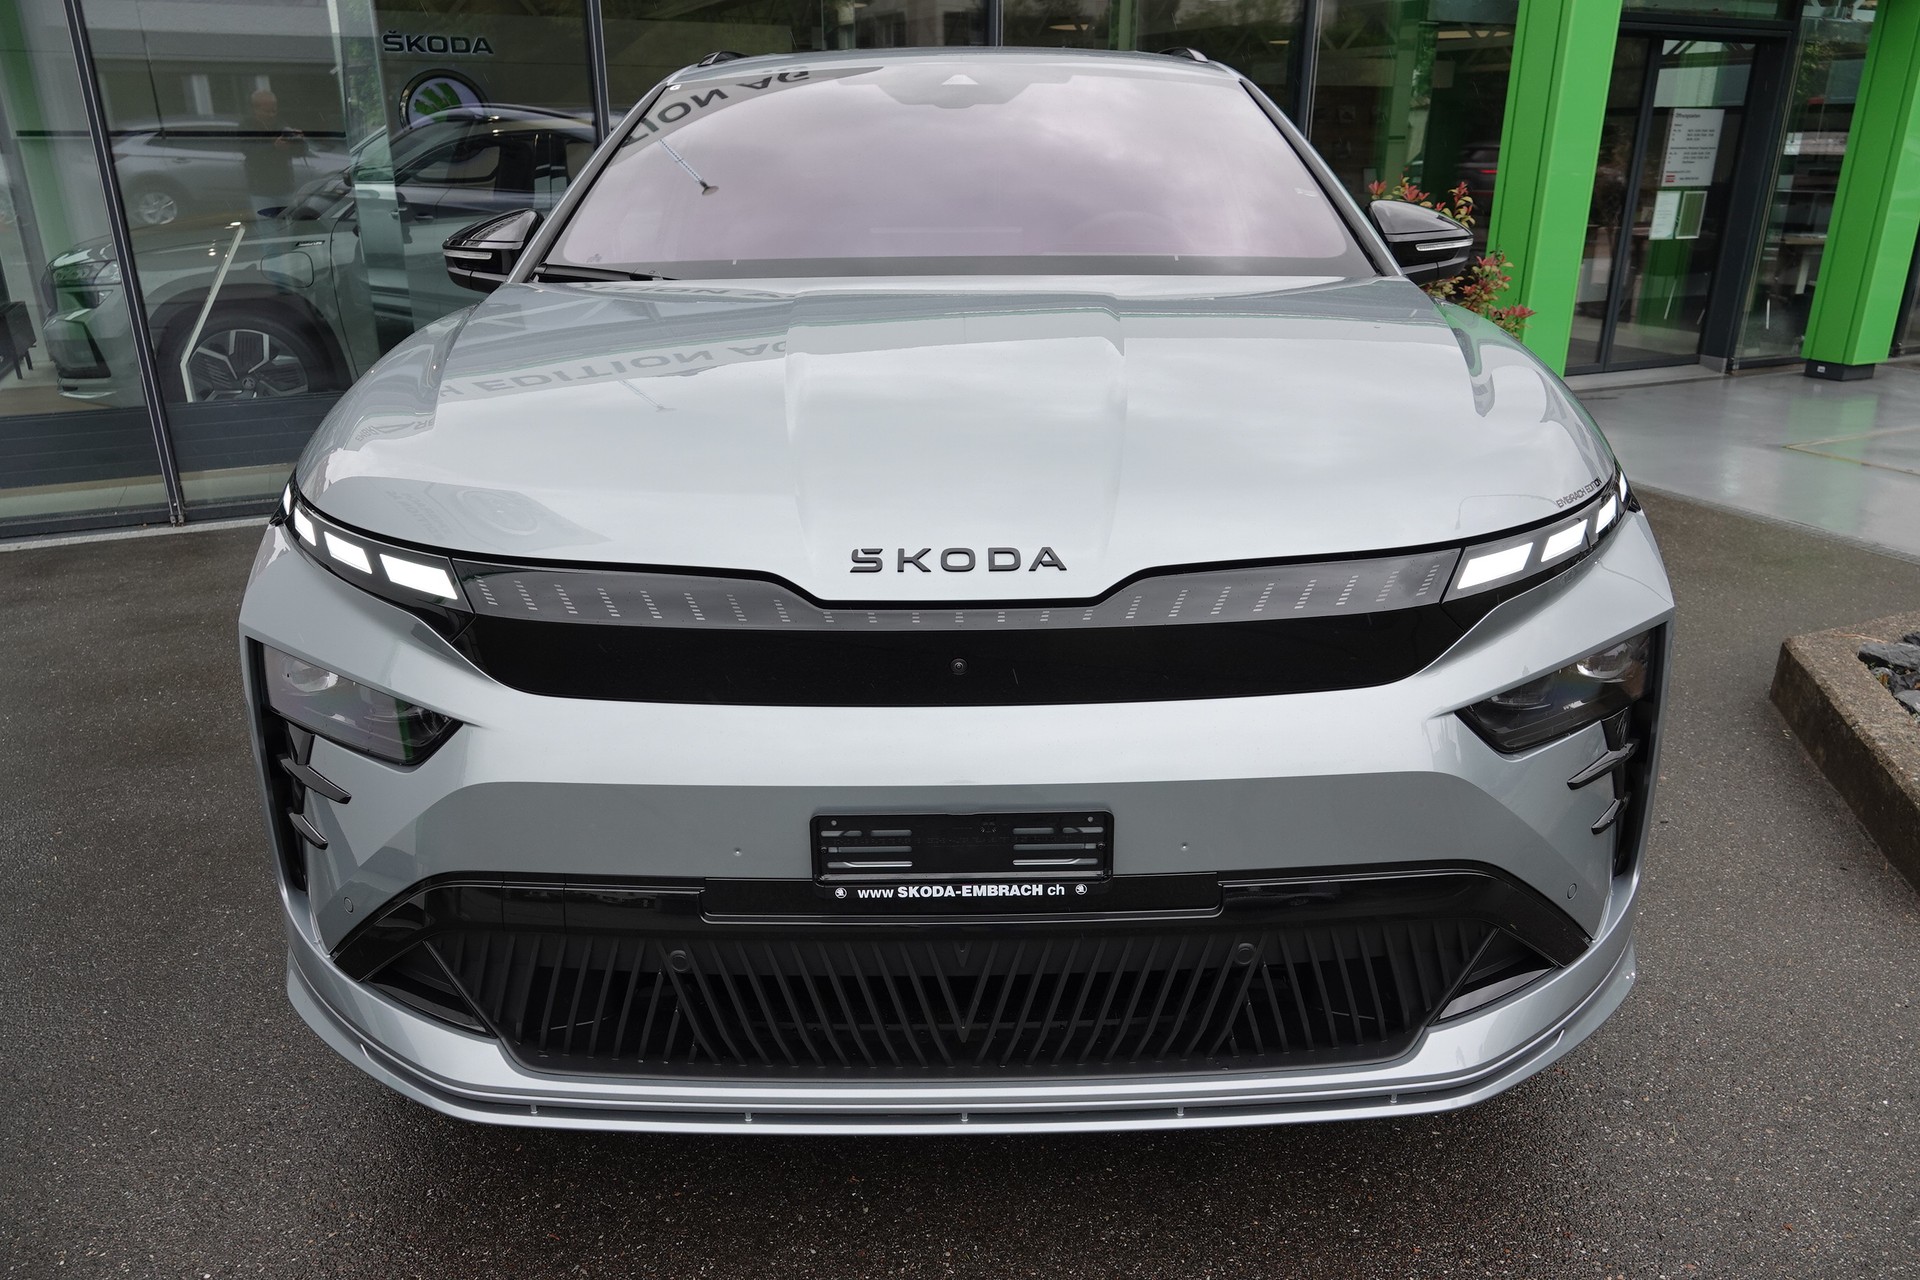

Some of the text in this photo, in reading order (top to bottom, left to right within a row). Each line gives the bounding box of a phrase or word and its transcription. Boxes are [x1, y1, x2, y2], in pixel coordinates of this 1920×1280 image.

[382, 30, 494, 54] ŠKODA
[897, 884, 1043, 898] SKODA-EMBRACH
[1047, 883, 1065, 896] ch
